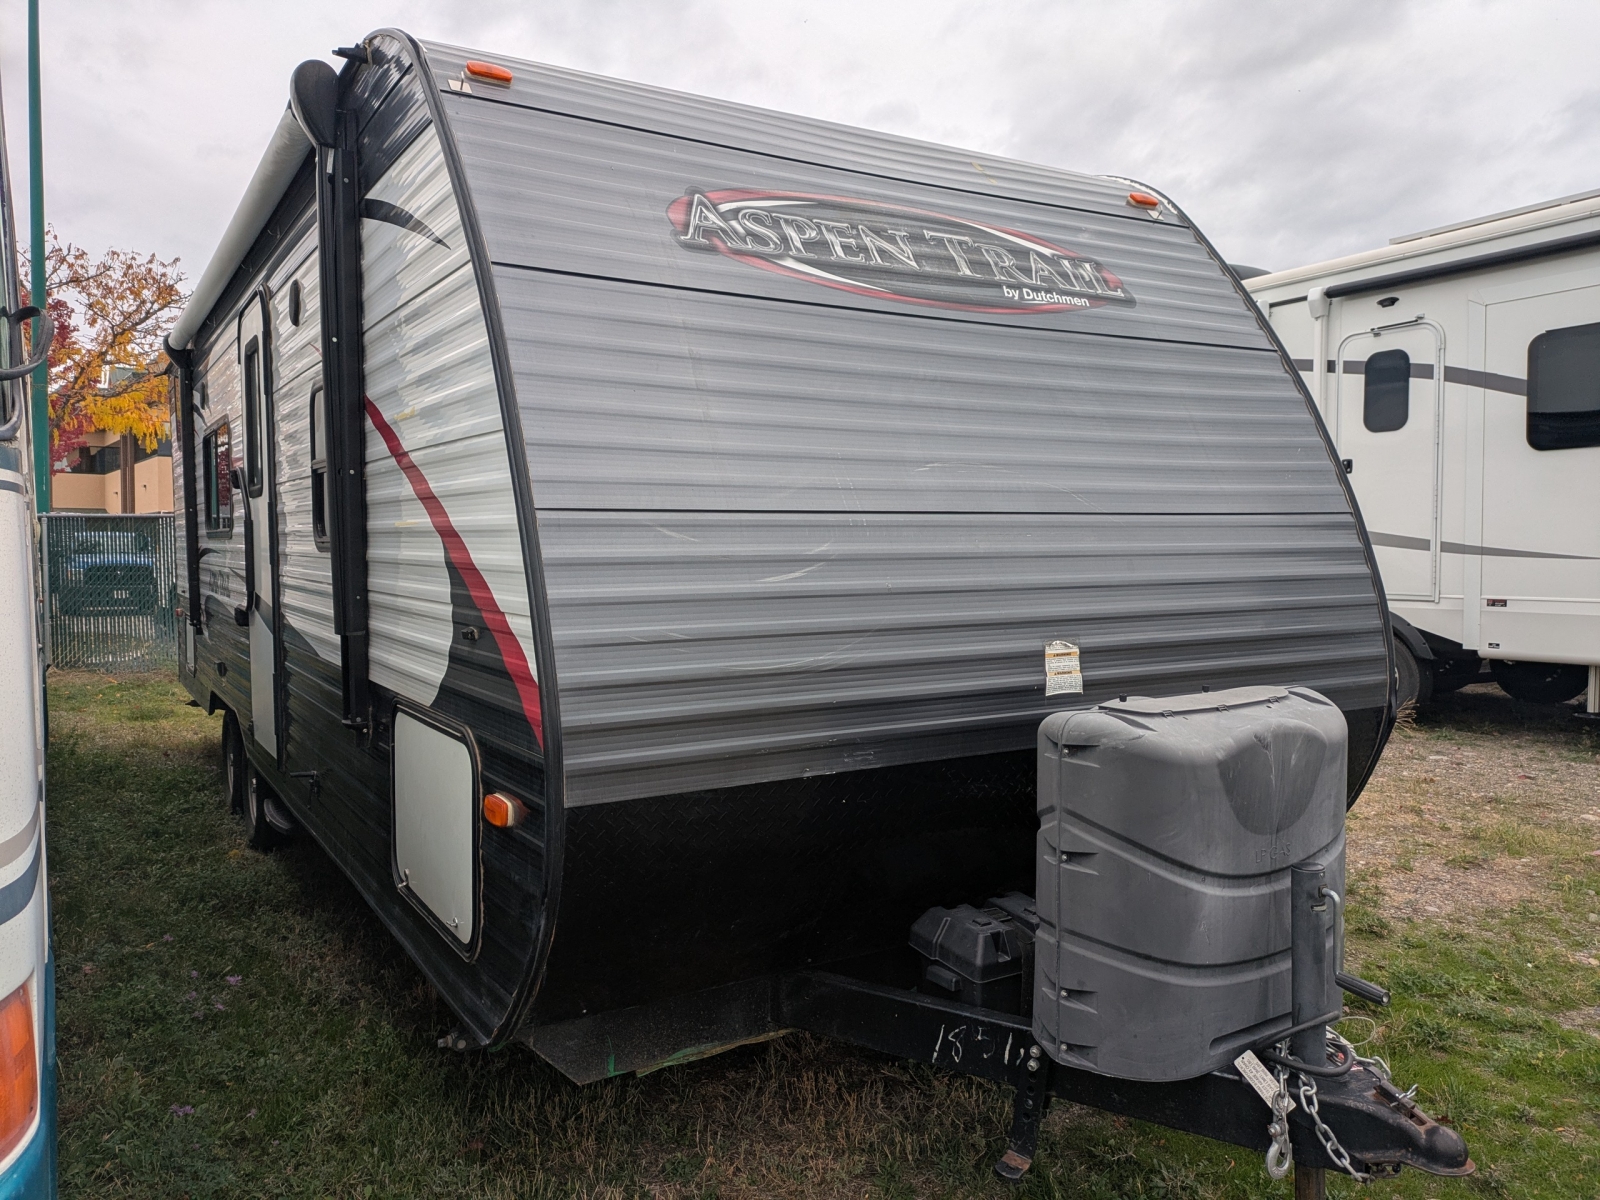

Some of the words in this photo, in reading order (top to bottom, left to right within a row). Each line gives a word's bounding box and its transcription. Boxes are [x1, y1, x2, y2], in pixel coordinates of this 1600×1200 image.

[679, 193, 922, 272] ASPEN
[923, 229, 1125, 298] TRAIL
[1003, 285, 1020, 300] by
[1022, 287, 1090, 308] Dutchmen
